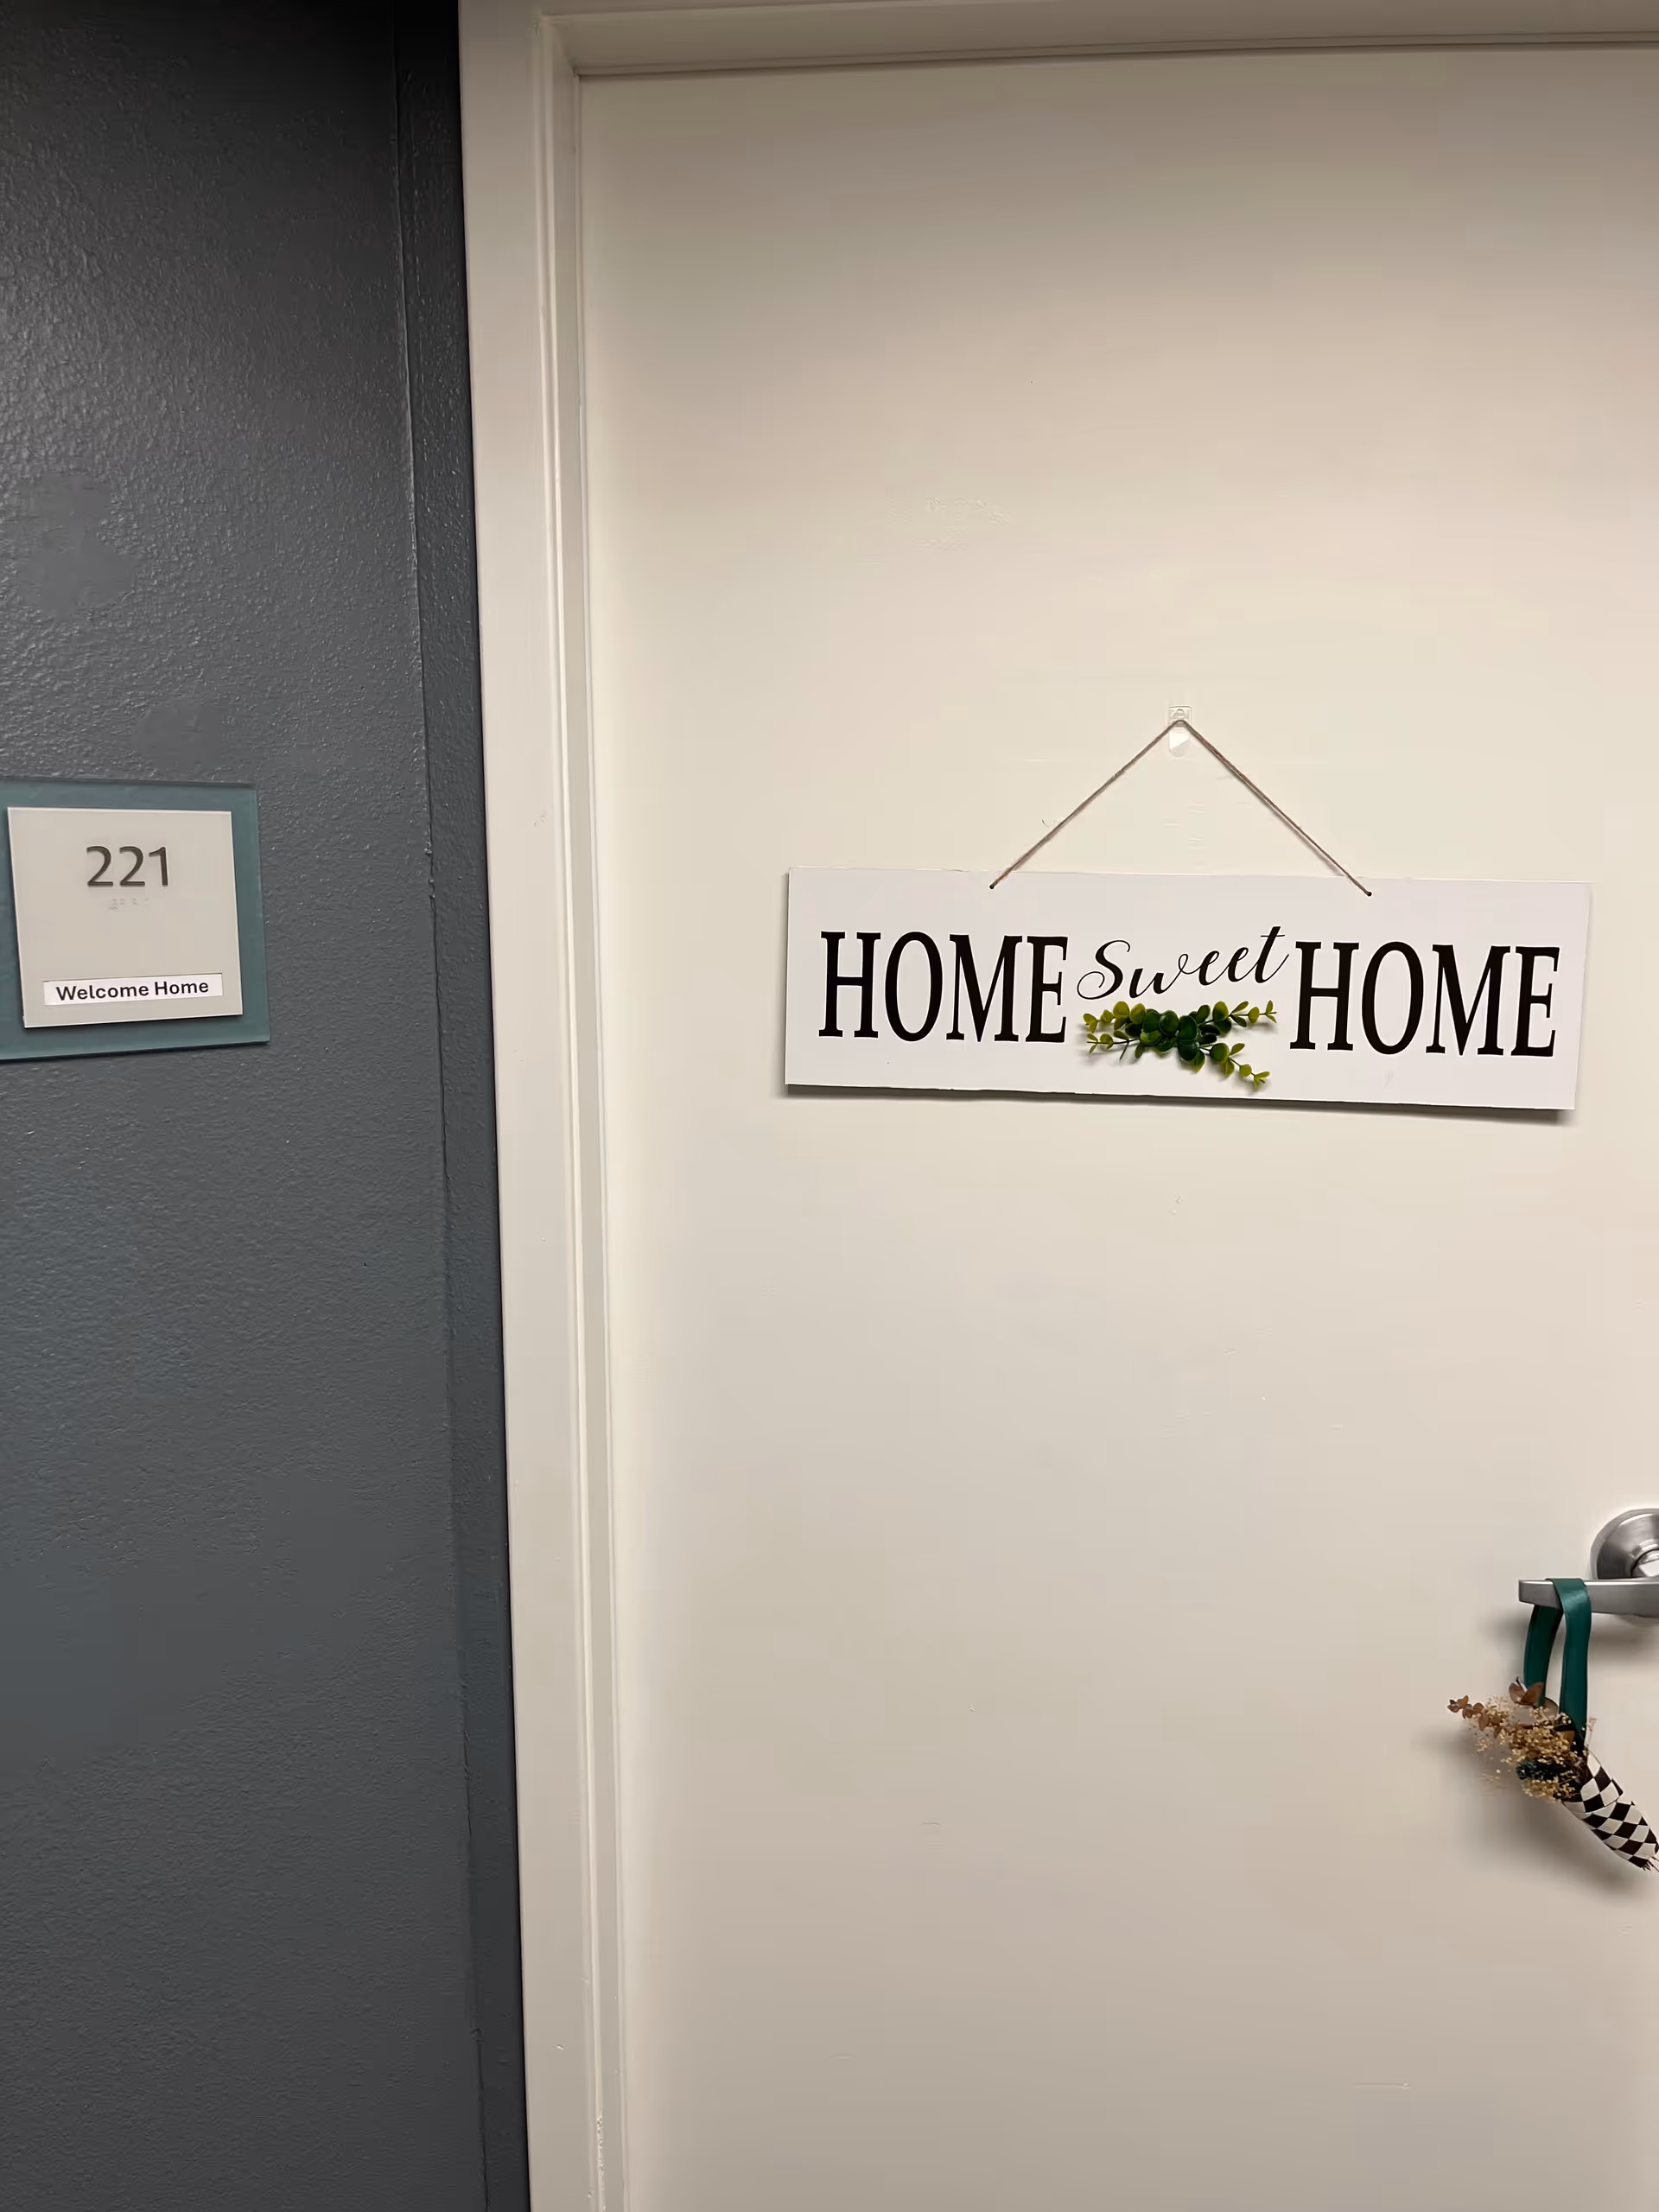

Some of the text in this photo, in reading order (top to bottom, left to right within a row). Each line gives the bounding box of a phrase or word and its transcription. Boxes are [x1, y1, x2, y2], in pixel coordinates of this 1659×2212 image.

[86, 845, 168, 887] 221
[55, 980, 209, 1001] Welcome Home
[818, 925, 1560, 1058] HOME Sweet HOME
